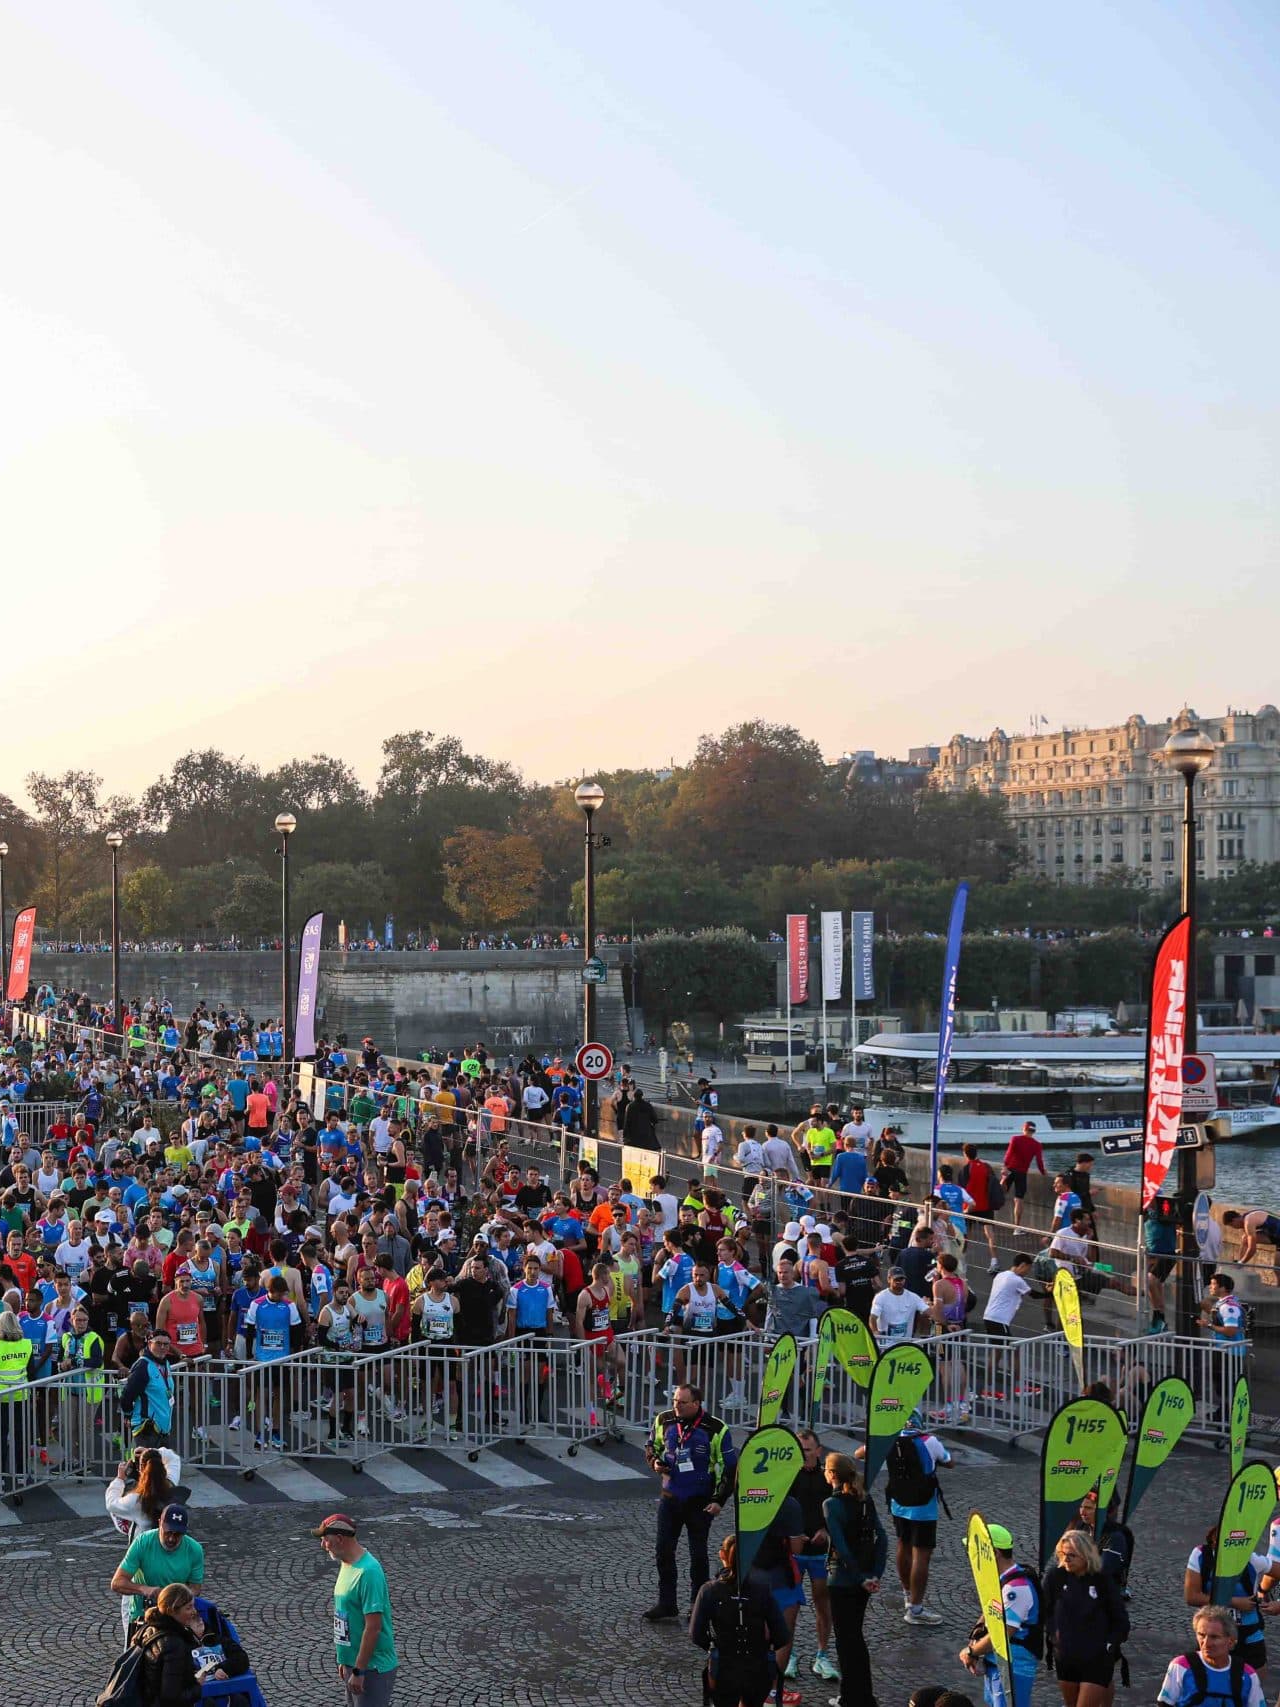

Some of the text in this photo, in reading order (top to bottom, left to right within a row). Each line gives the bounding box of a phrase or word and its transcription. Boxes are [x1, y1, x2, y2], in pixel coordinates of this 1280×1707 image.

[17, 914, 32, 923] SAS
[304, 925, 319, 936] SAS
[586, 1056, 603, 1067] 20
[1, 1352, 27, 1361] DEPART
[888, 1359, 922, 1385] 1H45
[875, 1404, 904, 1413] SPORT
[1157, 1391, 1184, 1416] 1H50
[1066, 1415, 1107, 1444] 1H55
[1142, 1434, 1168, 1444] SPORT
[753, 1447, 794, 1474] 2H05
[1051, 1466, 1088, 1475] SPORT
[739, 1495, 774, 1504] SPORT
[1238, 1481, 1267, 1513] 1H55
[1223, 1537, 1252, 1547] SPORT
